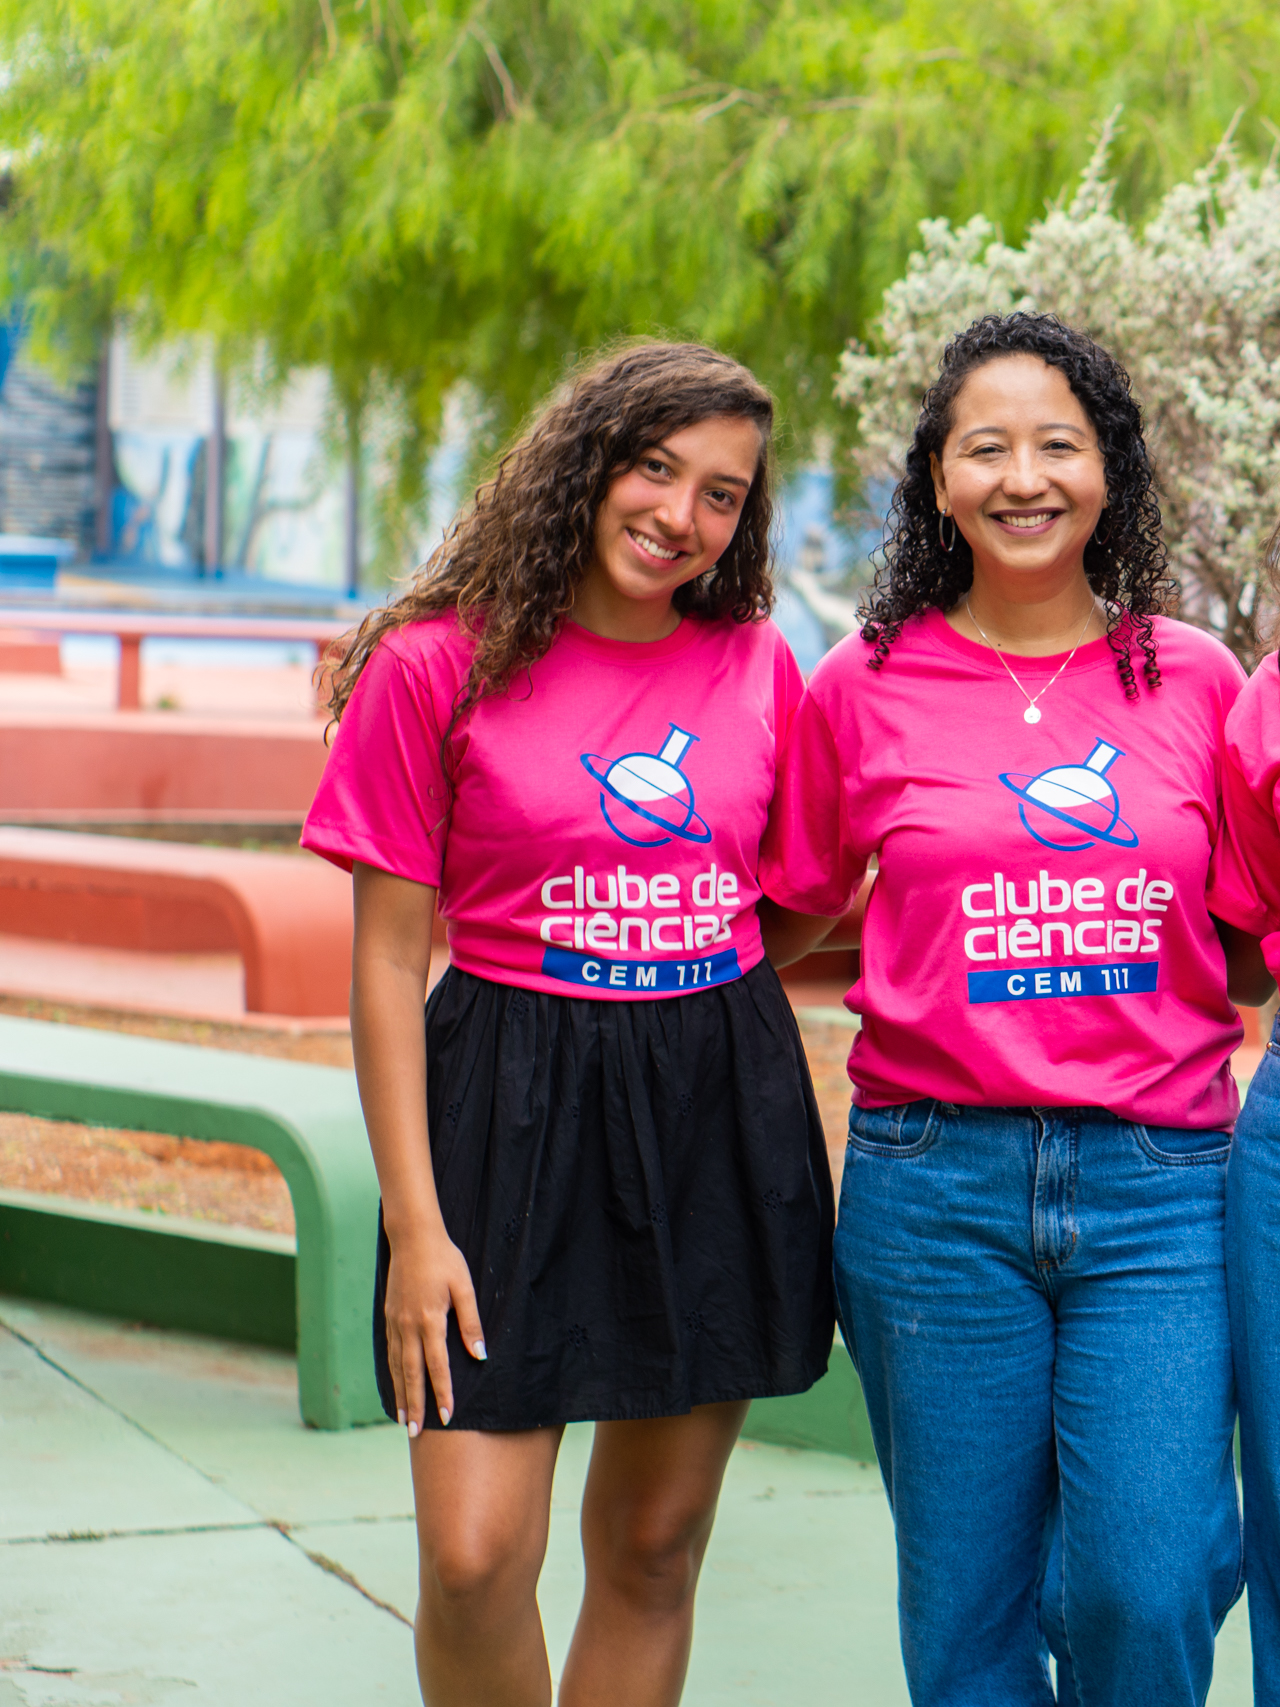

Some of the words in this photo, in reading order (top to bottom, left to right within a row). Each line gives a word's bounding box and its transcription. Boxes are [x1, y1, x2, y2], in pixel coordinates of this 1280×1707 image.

[541, 864, 681, 910] clube
[691, 862, 741, 907] de
[961, 869, 1105, 918] clube
[1116, 868, 1174, 912] de
[540, 911, 737, 951] ciências
[964, 918, 1163, 961] ciências
[581, 960, 657, 987] CEM
[677, 961, 712, 986] 111
[1006, 971, 1082, 996] CEM
[1101, 968, 1129, 991] 111
